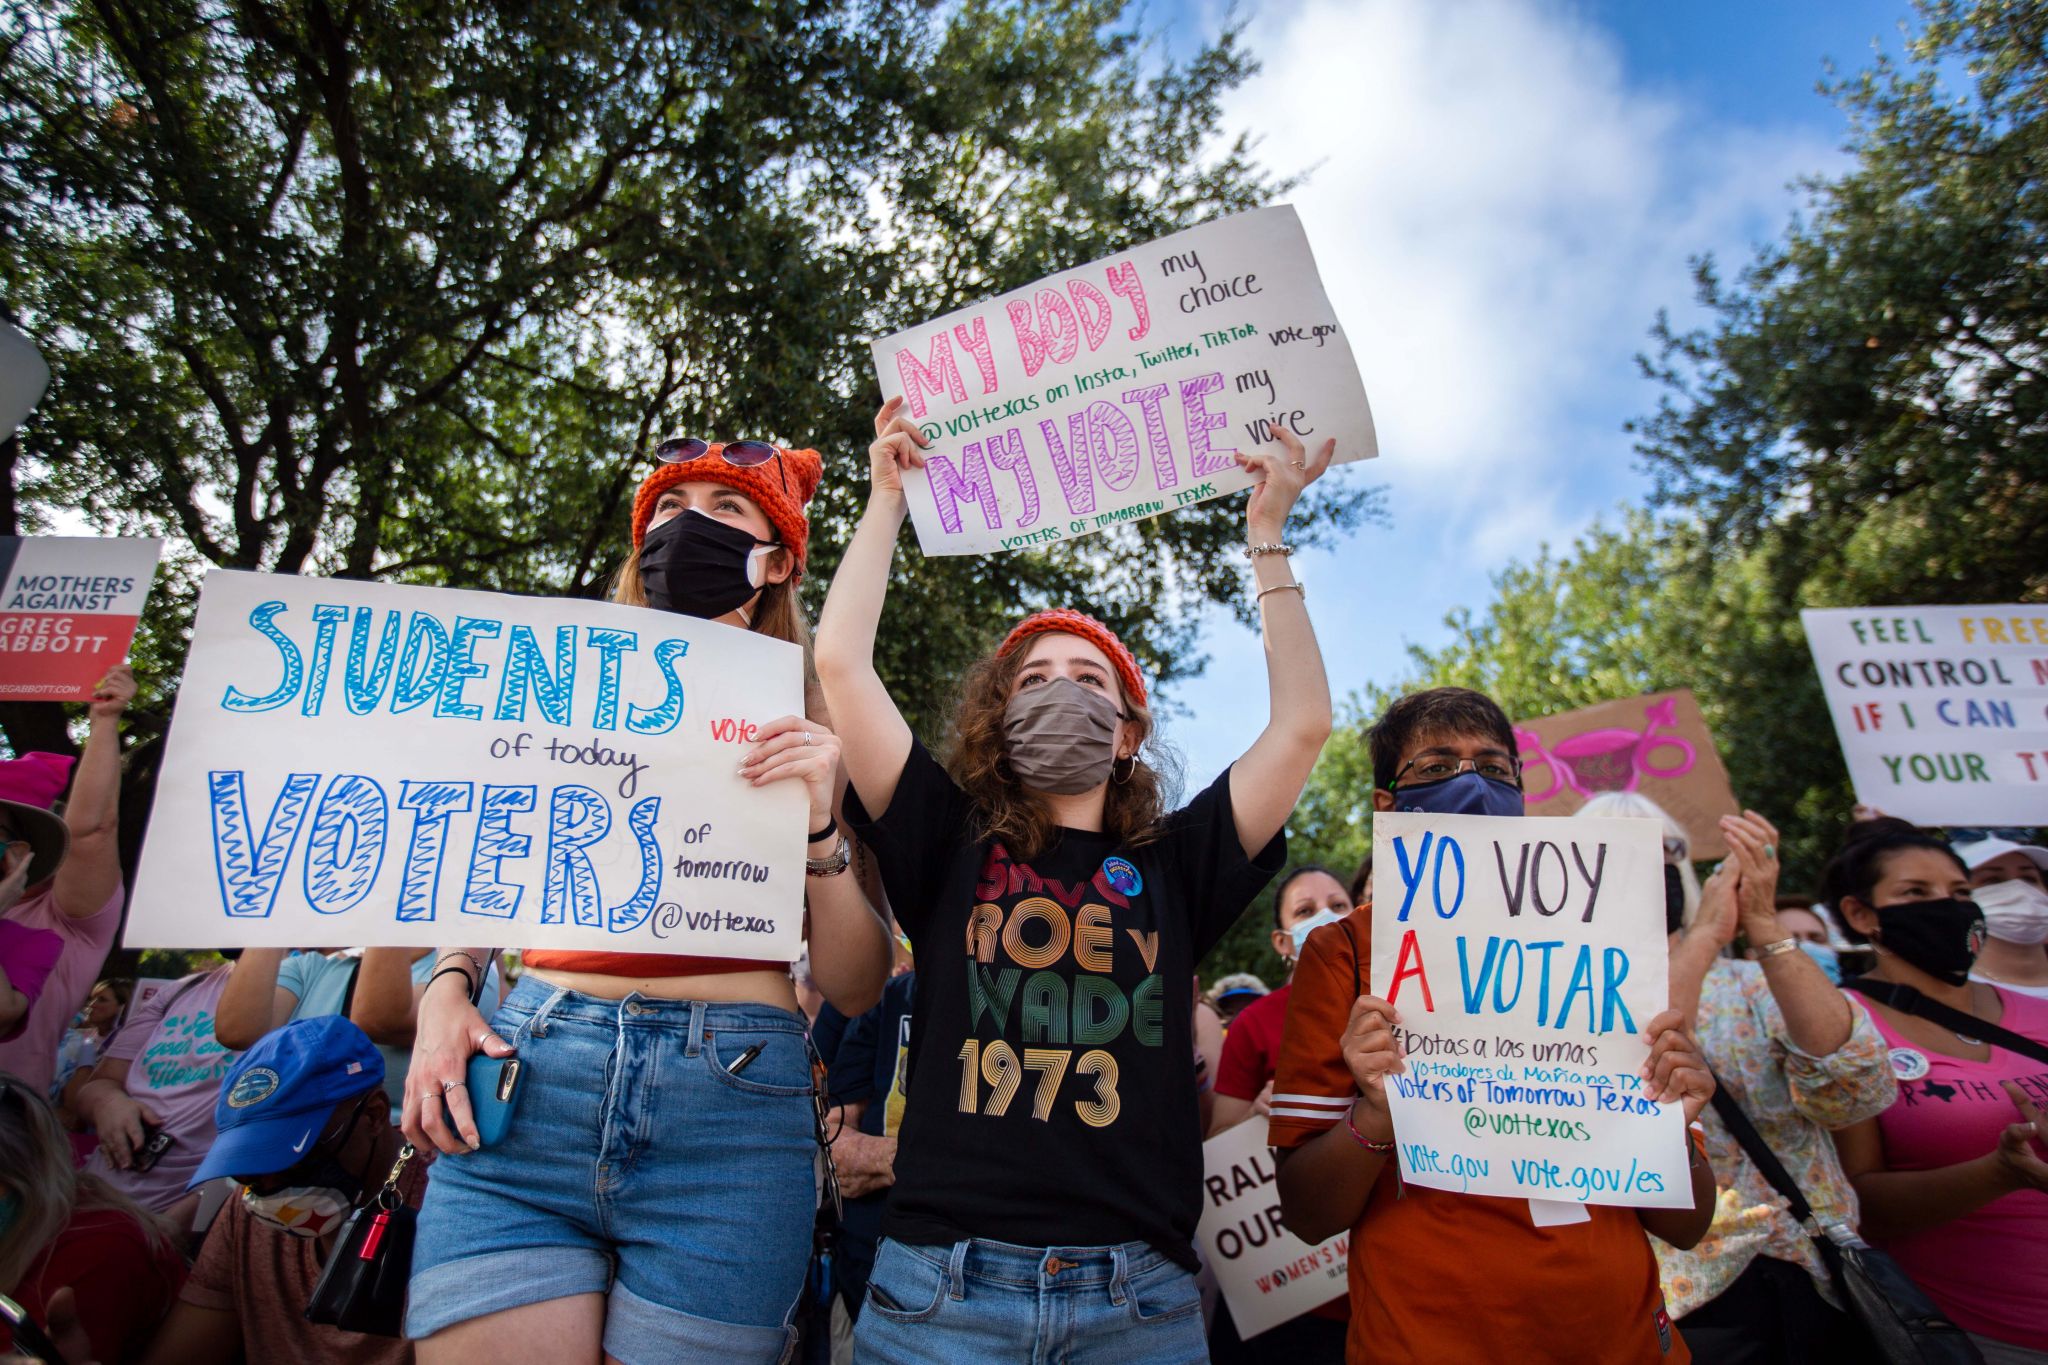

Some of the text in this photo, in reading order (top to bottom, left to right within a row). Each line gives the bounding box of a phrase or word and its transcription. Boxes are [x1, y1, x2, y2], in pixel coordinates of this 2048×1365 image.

[1160, 249, 1207, 284] my
[1180, 271, 1263, 314] choice
[896, 261, 1152, 420] MY BODY
[1046, 382, 1070, 404] on
[1074, 364, 1137, 395] Insta,
[1136, 342, 1200, 371] Twitter,
[1235, 369, 1276, 405] my
[925, 371, 1239, 535] MY VOTE
[1000, 482, 1218, 551] VOTERS OF TOMORROW TEXAS
[8, 593, 118, 611] AGAINST
[16, 575, 135, 594] MOTHERS
[0, 617, 75, 635] GREG
[1849, 616, 2048, 646] FEEL FREE
[220, 600, 691, 736] STUDENTS
[1837, 658, 2013, 688] CONTROL
[711, 718, 758, 745] vote
[1852, 701, 1884, 733] IF
[1898, 700, 1916, 730] I
[1936, 698, 2017, 729] CAN
[490, 735, 651, 800] of today
[1880, 753, 1992, 785] YOUR
[207, 769, 663, 935] VOTERS
[684, 823, 713, 844] of
[674, 855, 770, 884] tomorrow
[1392, 831, 1607, 923] YO VOY
[965, 896, 1114, 973] ROE
[966, 956, 1164, 1047] WADE
[1386, 929, 1638, 1035] A VOTAR
[1473, 1039, 1488, 1059] a
[1495, 1036, 1526, 1059] las
[957, 1038, 1121, 1128] 1973
[1457, 1078, 1478, 1104] of
[1479, 1080, 1586, 1108] Tomorrow
[1587, 1085, 1662, 1117] Texas
[1524, 1066, 1613, 1085] Mañana
[1615, 1073, 1643, 1091] TX
[1402, 1142, 1666, 1202] vote.gov vote.gov/es
